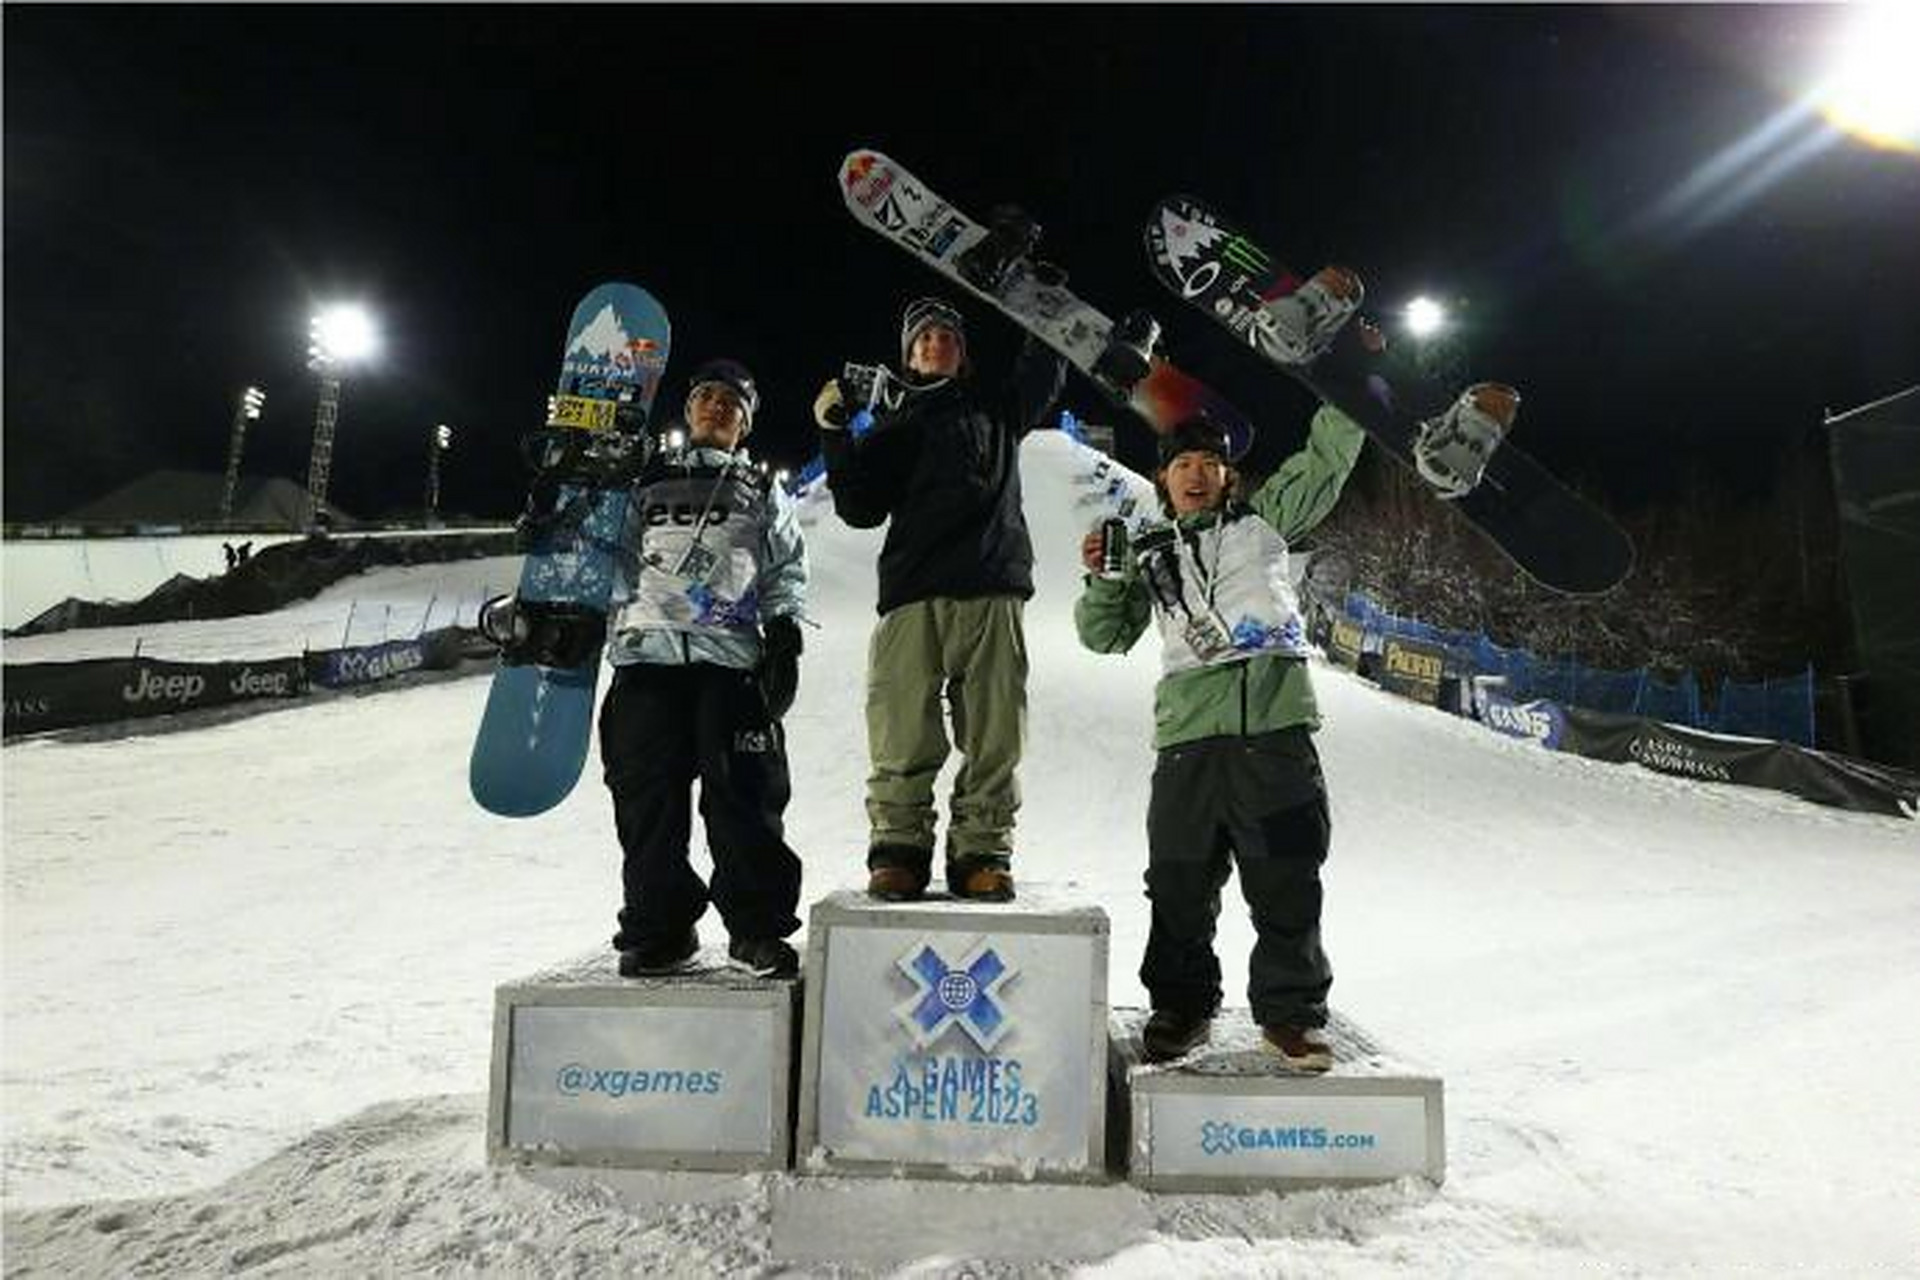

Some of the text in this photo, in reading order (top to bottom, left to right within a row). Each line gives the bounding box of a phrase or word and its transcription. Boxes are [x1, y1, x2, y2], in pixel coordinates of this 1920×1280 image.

[646, 503, 730, 526] eep
[124, 667, 205, 702] Jeep
[230, 668, 290, 695] Jeep
[557, 1063, 723, 1098] @xgames
[923, 1056, 1021, 1094] GAMES
[866, 1084, 1038, 1125] ASPEN 2023
